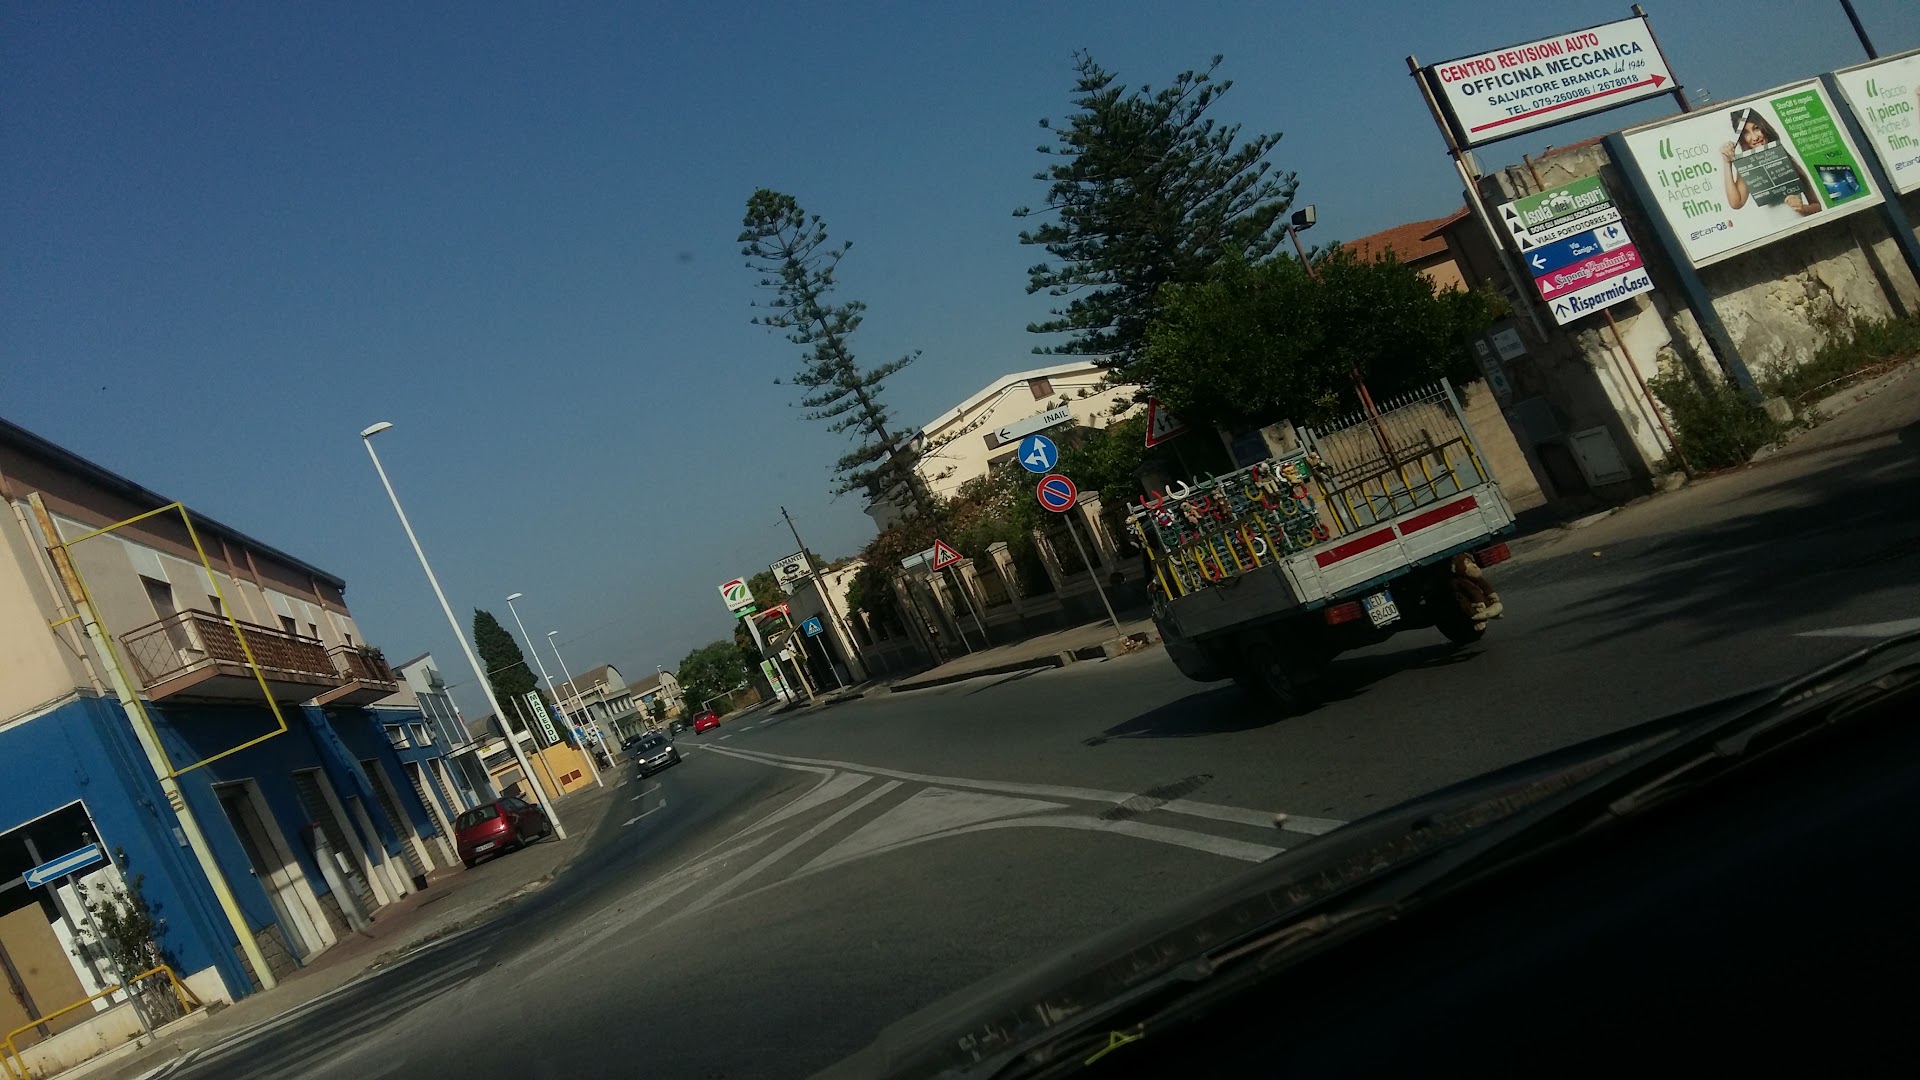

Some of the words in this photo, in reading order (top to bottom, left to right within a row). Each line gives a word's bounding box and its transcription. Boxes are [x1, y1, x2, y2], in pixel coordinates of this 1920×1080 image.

[1440, 57, 1496, 83] CENTRO
[1497, 42, 1563, 68] REVISIONI
[1566, 33, 1599, 53] AUTO
[1461, 64, 1544, 96] OFFICINA
[1547, 42, 1643, 74] MECCANICA
[1489, 80, 1559, 106] SALVATORE
[1562, 67, 1610, 87] BRANCA
[1613, 60, 1625, 74] dal
[1628, 59, 1645, 70] 1946
[1506, 105, 1530, 116] TEL.
[1532, 87, 1590, 108] 079-260086
[1598, 74, 1639, 91] 2678018
[1866, 107, 1877, 122] il
[1877, 122, 1901, 136] Anche
[1900, 118, 1909, 130] di
[1658, 171, 1670, 188] il
[1668, 184, 1701, 202] Anche
[1702, 178, 1713, 192] di
[1523, 206, 1553, 224] Isola
[1555, 200, 1569, 213] dei
[1569, 187, 1605, 209] Tesori
[1531, 224, 1544, 234] DOVE
[1553, 214, 1574, 227] ANIMALI
[1574, 210, 1589, 219] SONO
[1536, 232, 1557, 244] VIALE
[1558, 216, 1607, 236] PORTOTORRES
[1607, 212, 1618, 220] 24
[1569, 276, 1650, 313] RisparmioCasa
[1044, 410, 1068, 424] INAIL
[772, 553, 803, 570] DIAMANTE
[1371, 604, 1396, 622] 68400
[530, 694, 557, 741] MARCEDDU
